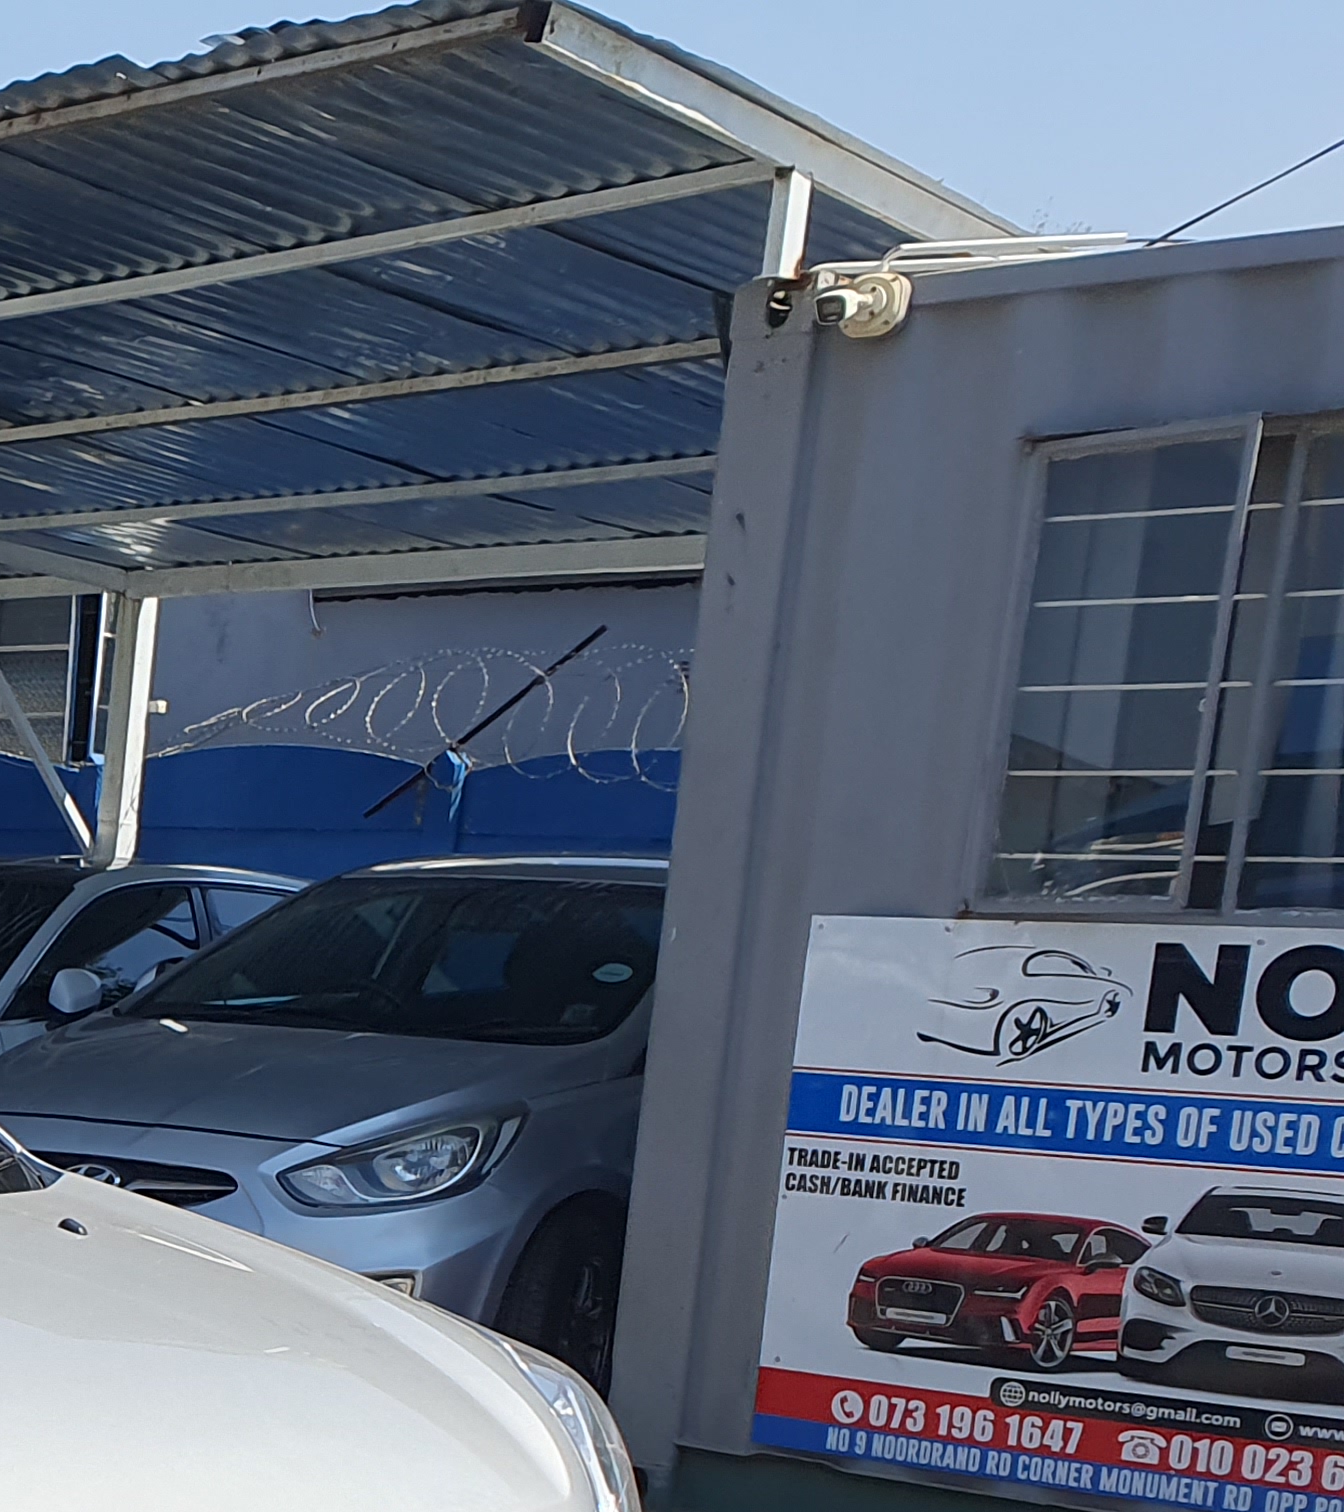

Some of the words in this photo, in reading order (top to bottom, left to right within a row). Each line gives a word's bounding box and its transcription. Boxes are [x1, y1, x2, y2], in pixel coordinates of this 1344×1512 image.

[1143, 942, 1344, 1042] NO
[838, 1083, 948, 1130] DEALER
[956, 1092, 990, 1132] IN
[995, 1095, 1052, 1137] ALL
[1065, 1099, 1167, 1146] TYPES
[1176, 1106, 1222, 1149] OF
[1229, 1110, 1321, 1156] USED
[784, 1172, 887, 1201] CASH/BANK
[890, 1181, 967, 1208] FINANCE
[787, 1147, 865, 1173] TRADE-IN
[868, 1154, 961, 1181] ACCEPTED
[868, 1394, 927, 1432] 073
[935, 1404, 995, 1443] 196
[1004, 1414, 1084, 1455] 1647
[1168, 1434, 1234, 1477] 010
[1240, 1443, 1314, 1487] 023
[1321, 1454, 1344, 1492] 6
[1027, 1389, 1241, 1429] nollymotors@gmail.com
[825, 1426, 850, 1453] NO
[855, 1431, 867, 1455] 9
[870, 1433, 982, 1473] NOORDRAND
[985, 1450, 1012, 1478] RD
[1016, 1453, 1094, 1490] CORNER
[1098, 1464, 1219, 1508] MONUMENT
[1222, 1484, 1253, 1512] RD
